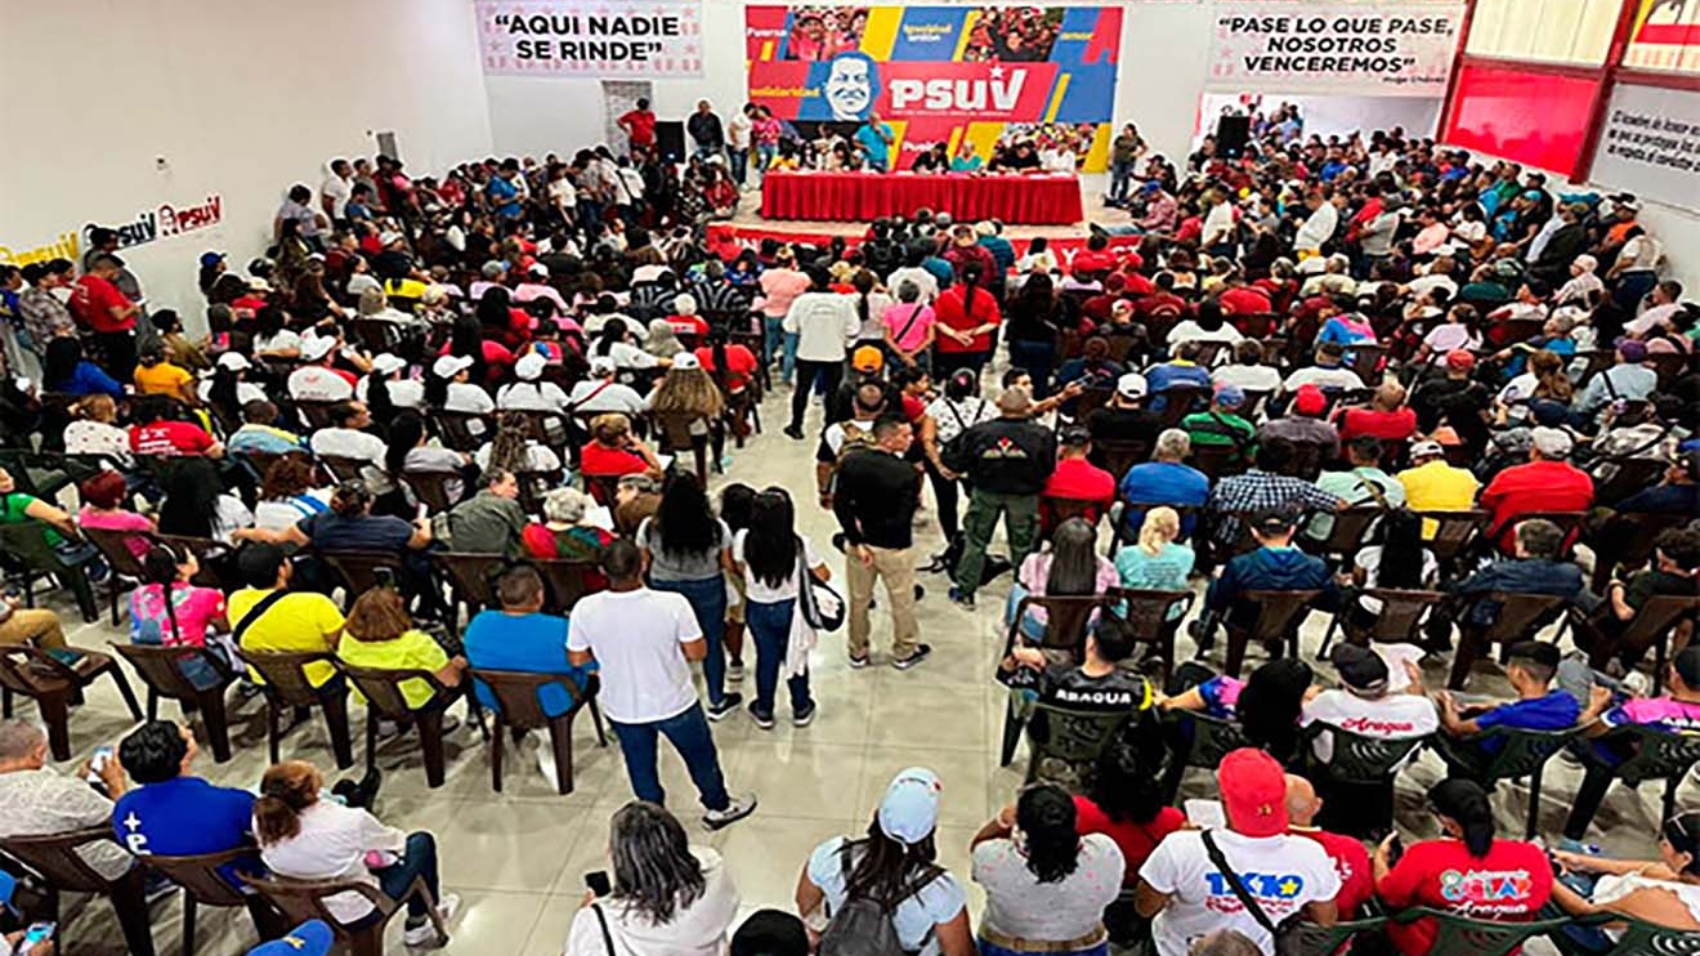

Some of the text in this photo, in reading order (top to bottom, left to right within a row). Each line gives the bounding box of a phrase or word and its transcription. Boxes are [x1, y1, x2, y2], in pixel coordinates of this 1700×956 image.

[495, 15, 679, 36] “AQUI NADIE
[1295, 18, 1326, 33] LO
[1332, 18, 1382, 34] QUE
[1387, 18, 1453, 36] PASE,
[516, 40, 662, 61] SE RINDE”
[1267, 37, 1397, 53] NOSOTROS
[1244, 56, 1416, 73] VENCEREMOS”
[1341, 716, 1414, 735] Aragua
